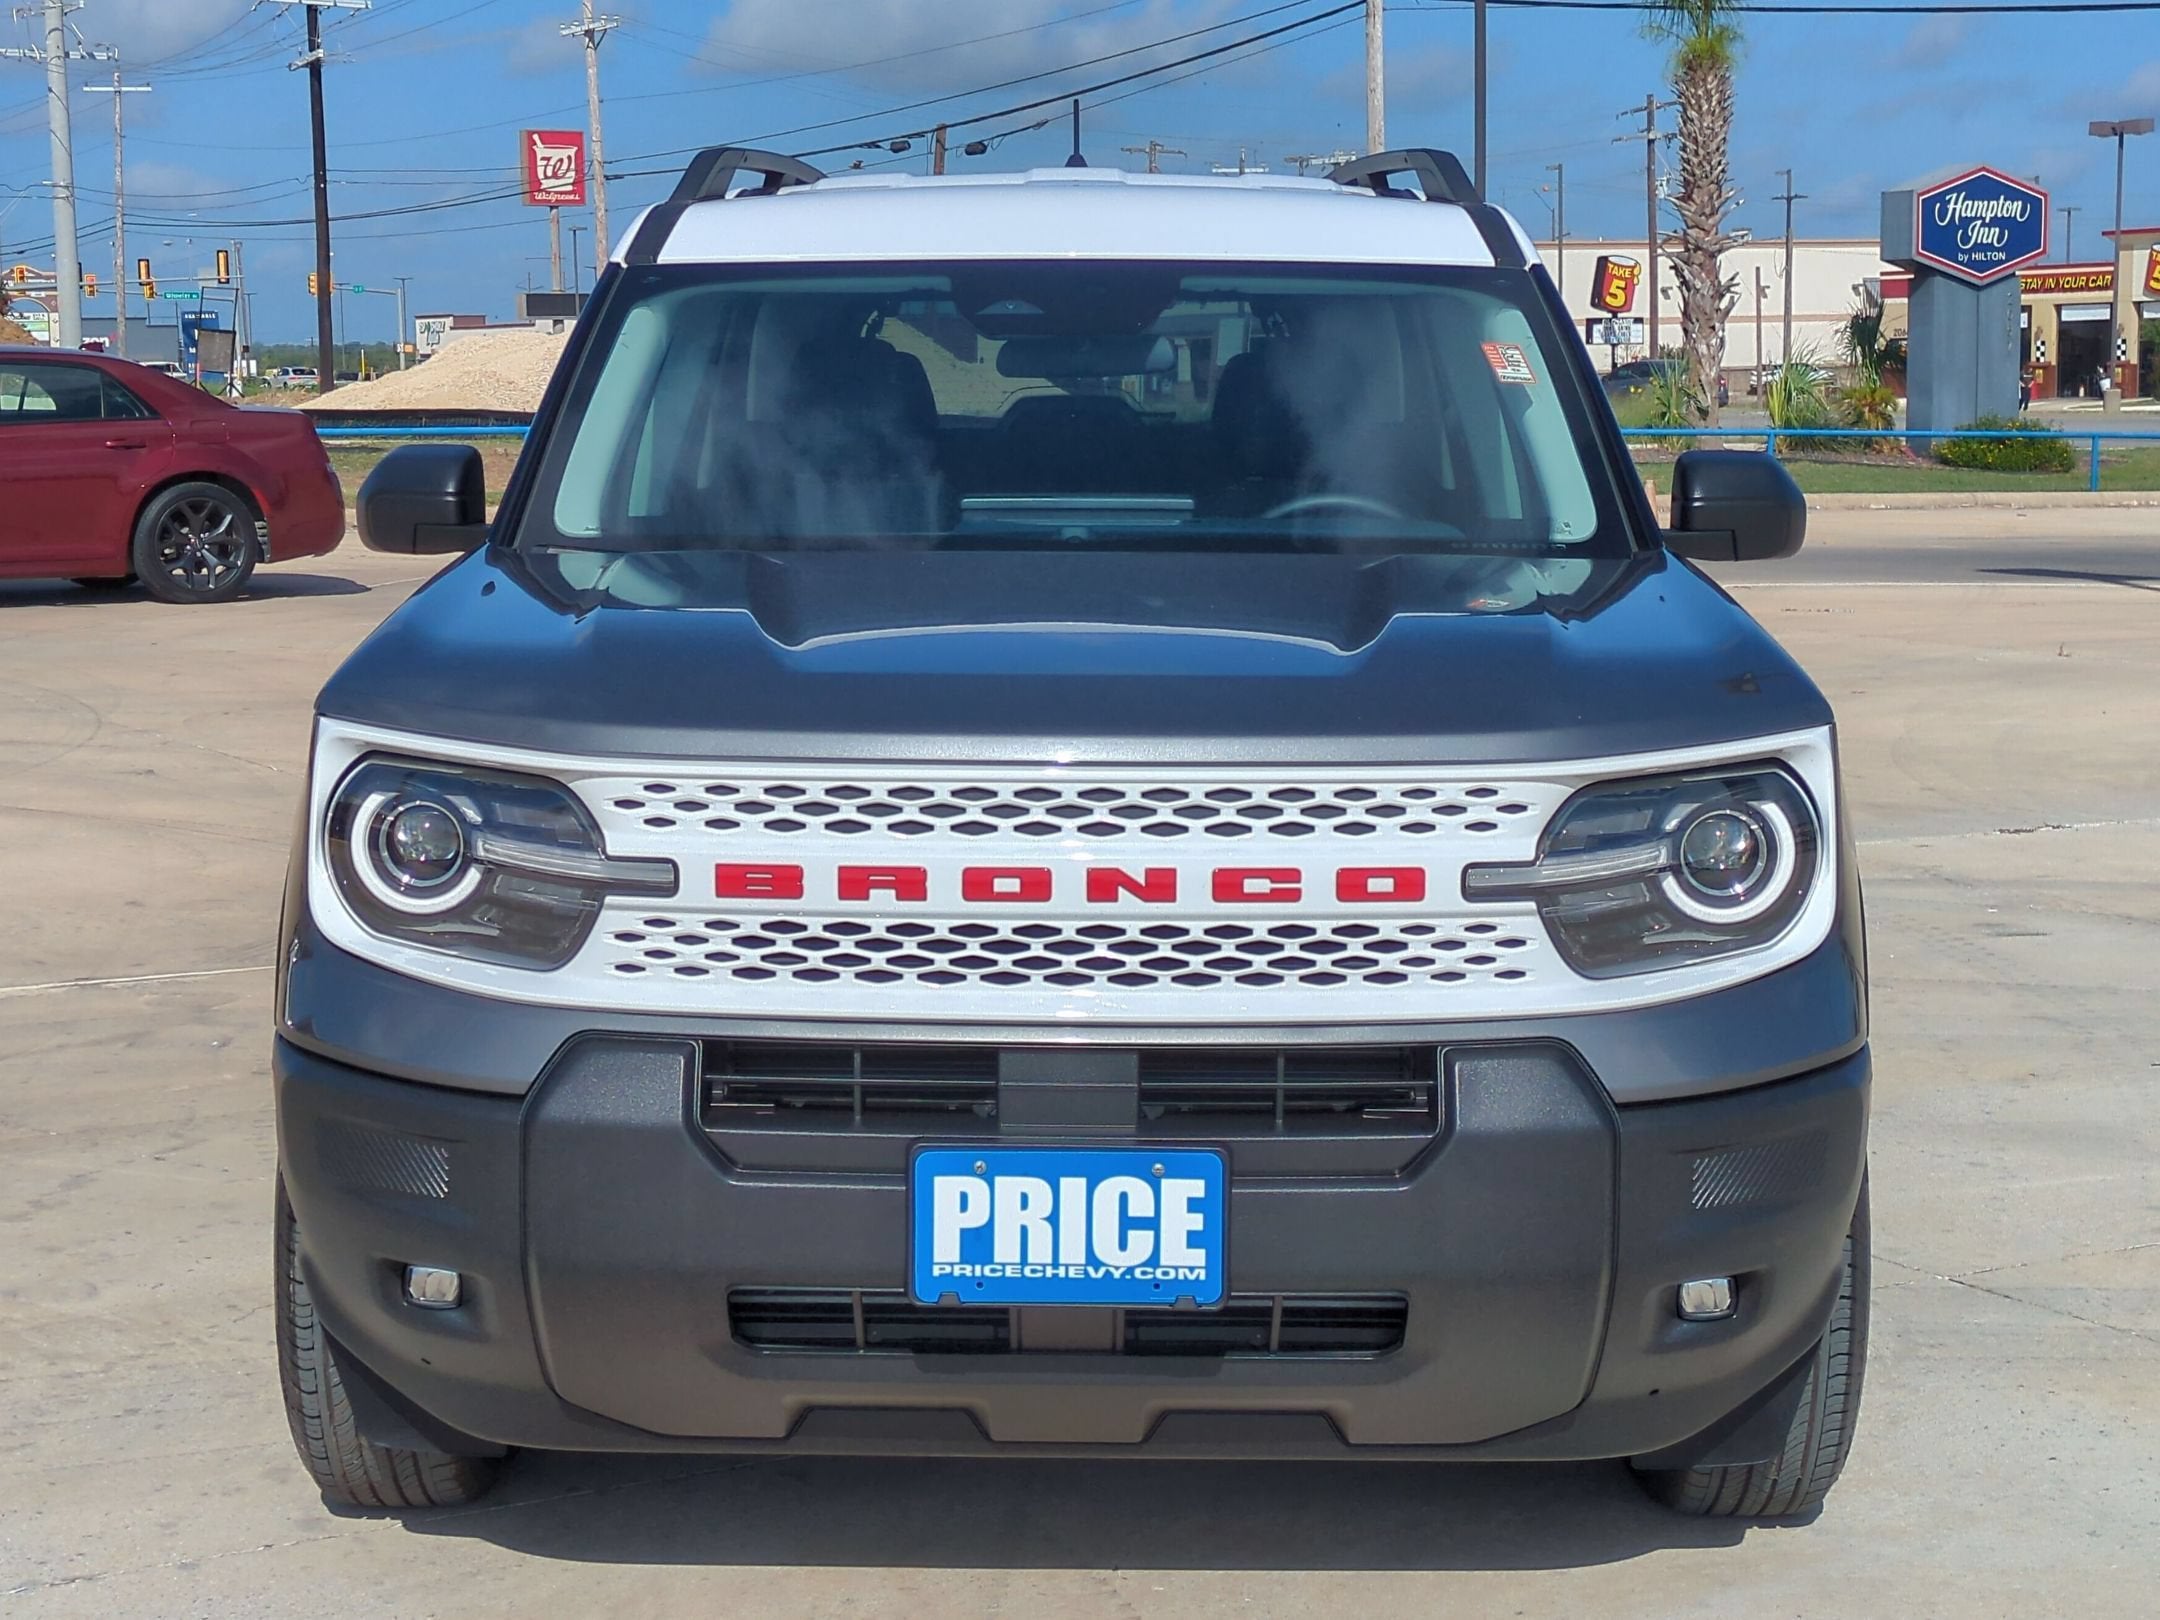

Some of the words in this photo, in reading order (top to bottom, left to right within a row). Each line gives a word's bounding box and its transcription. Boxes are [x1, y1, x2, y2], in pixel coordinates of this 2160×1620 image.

[533, 192, 580, 203] Walgreens
[1935, 191, 2031, 226] Hampton
[1957, 219, 2009, 249] Inn
[1958, 252, 1969, 263] by
[1971, 251, 2006, 261] HILTON
[1607, 263, 1633, 278] TAKE
[1605, 278, 1626, 307] 5
[2020, 277, 2042, 290] STAY
[2044, 279, 2056, 289] IN
[2059, 276, 2086, 289] YOUR
[2088, 275, 2112, 288] CAR
[714, 862, 1426, 904] BRONCO
[933, 1175, 1206, 1268] PRICE
[932, 1263, 1206, 1281] PRICECHEVY.COM
